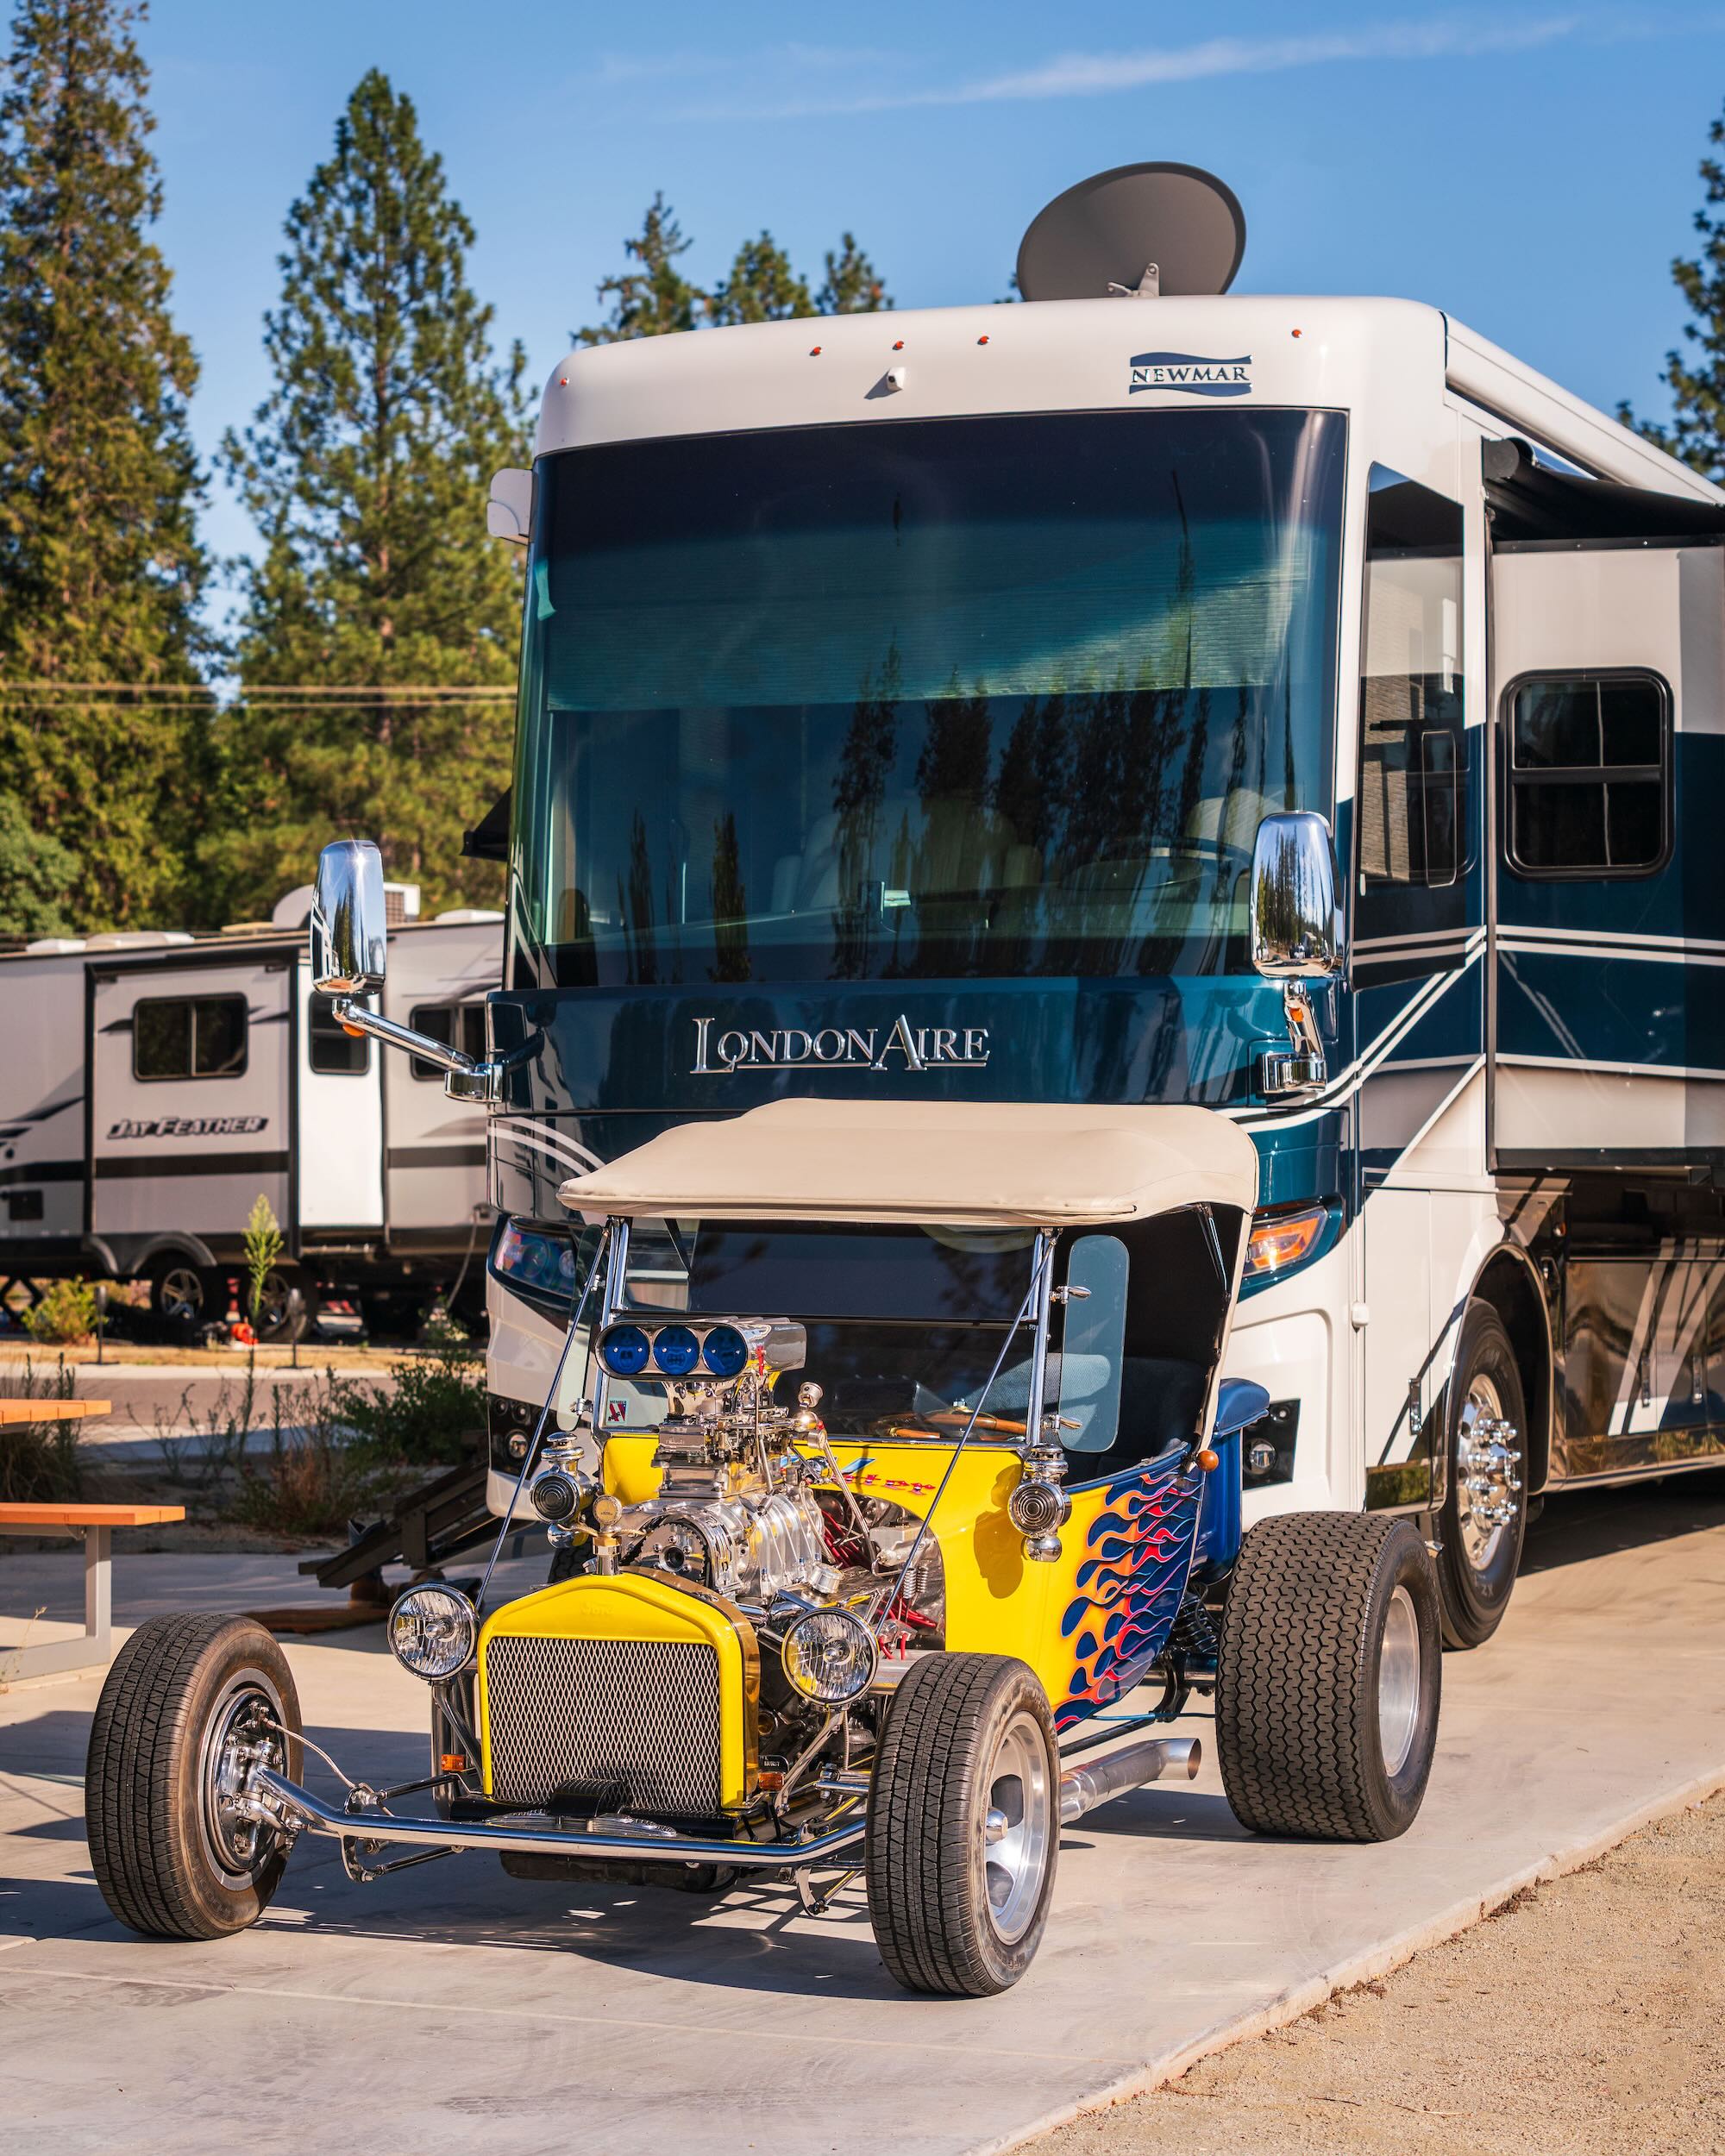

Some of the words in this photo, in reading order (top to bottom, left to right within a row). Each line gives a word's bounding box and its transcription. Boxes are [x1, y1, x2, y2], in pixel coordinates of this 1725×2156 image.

[1132, 367, 1250, 383] NEWMAR
[690, 1013, 991, 1073] LONDONAIRE
[107, 1119, 152, 1139] JAY
[156, 1116, 263, 1137] FEATHER
